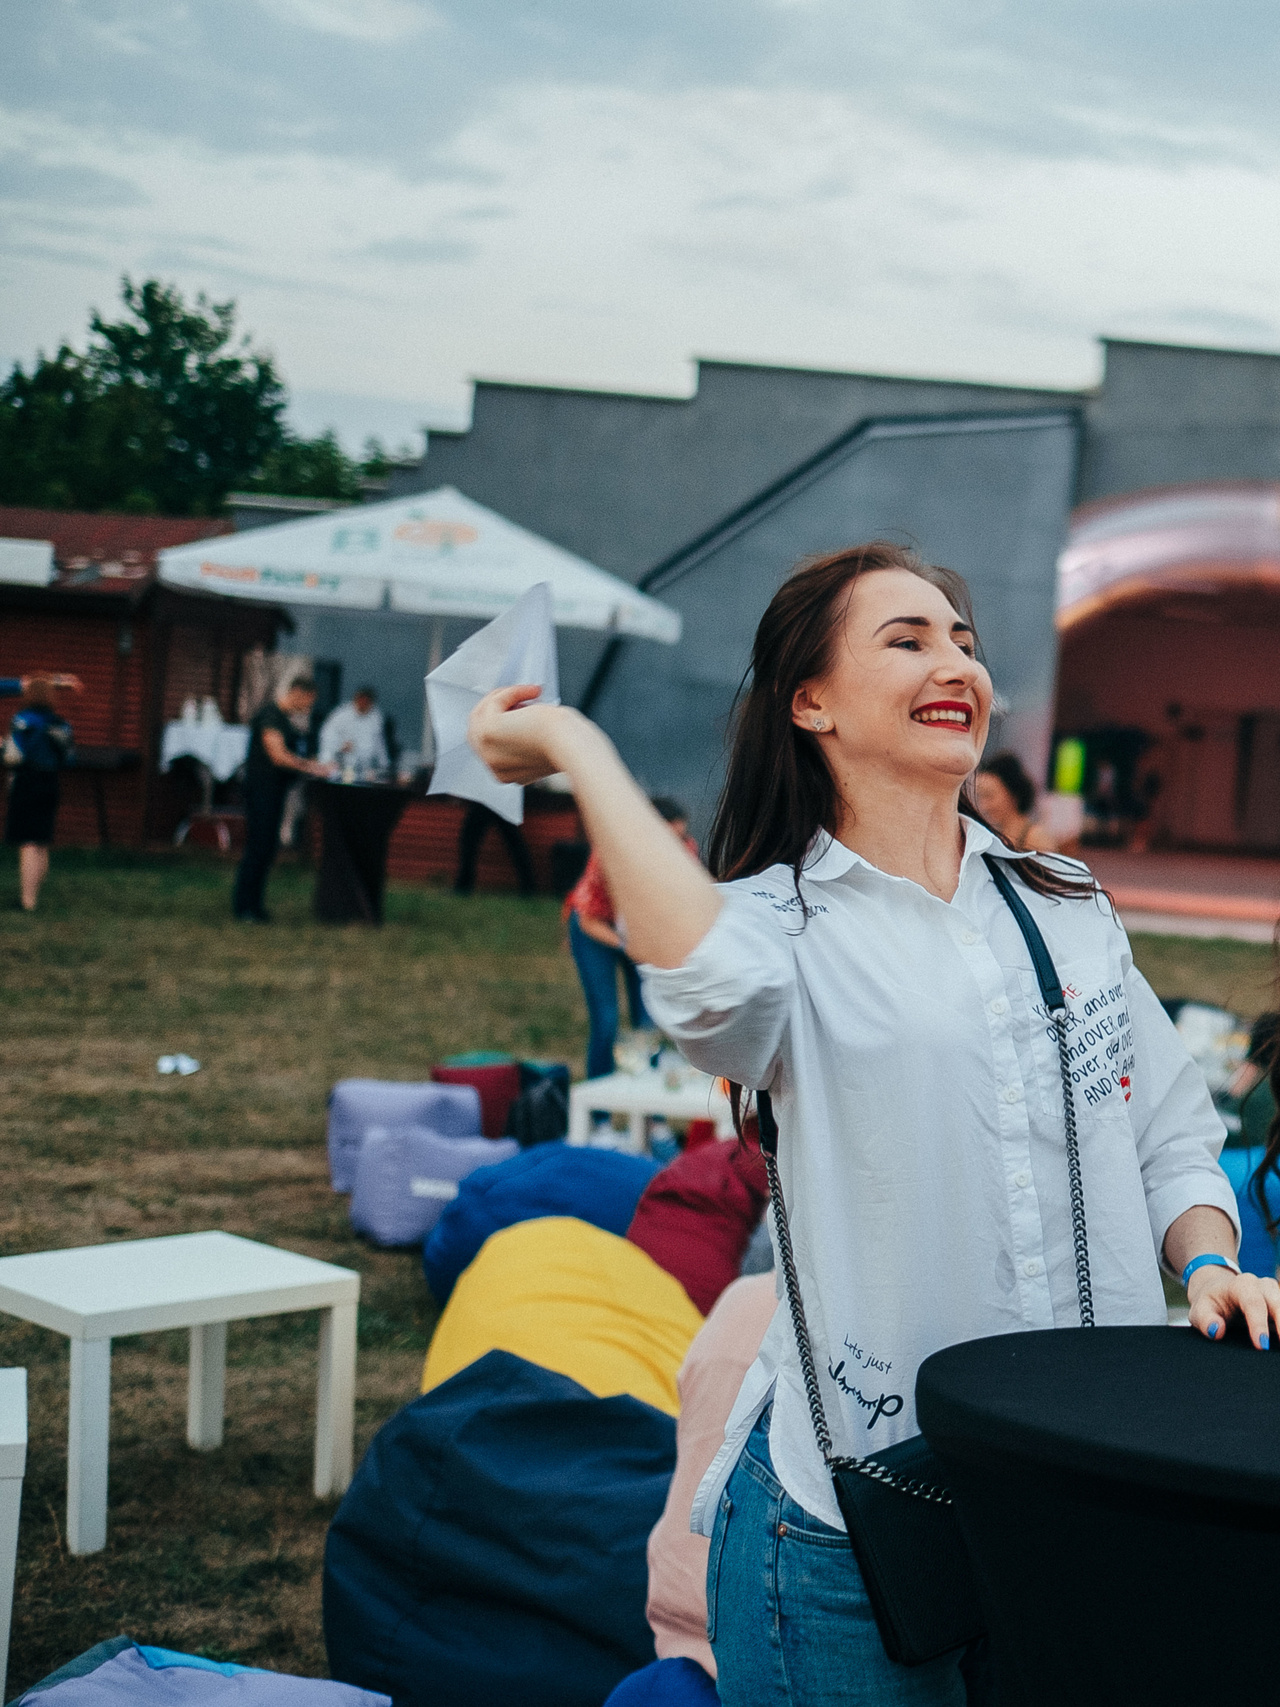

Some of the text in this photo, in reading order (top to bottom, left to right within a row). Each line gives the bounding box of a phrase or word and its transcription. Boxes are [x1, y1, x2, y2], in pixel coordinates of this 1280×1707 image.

[1084, 989, 1108, 1016] and
[1067, 1036, 1088, 1063] nd
[1071, 1054, 1107, 1083] over,
[1105, 1036, 1120, 1060] ad
[1083, 1078, 1112, 1106] AND
[862, 1352, 893, 1374] just
